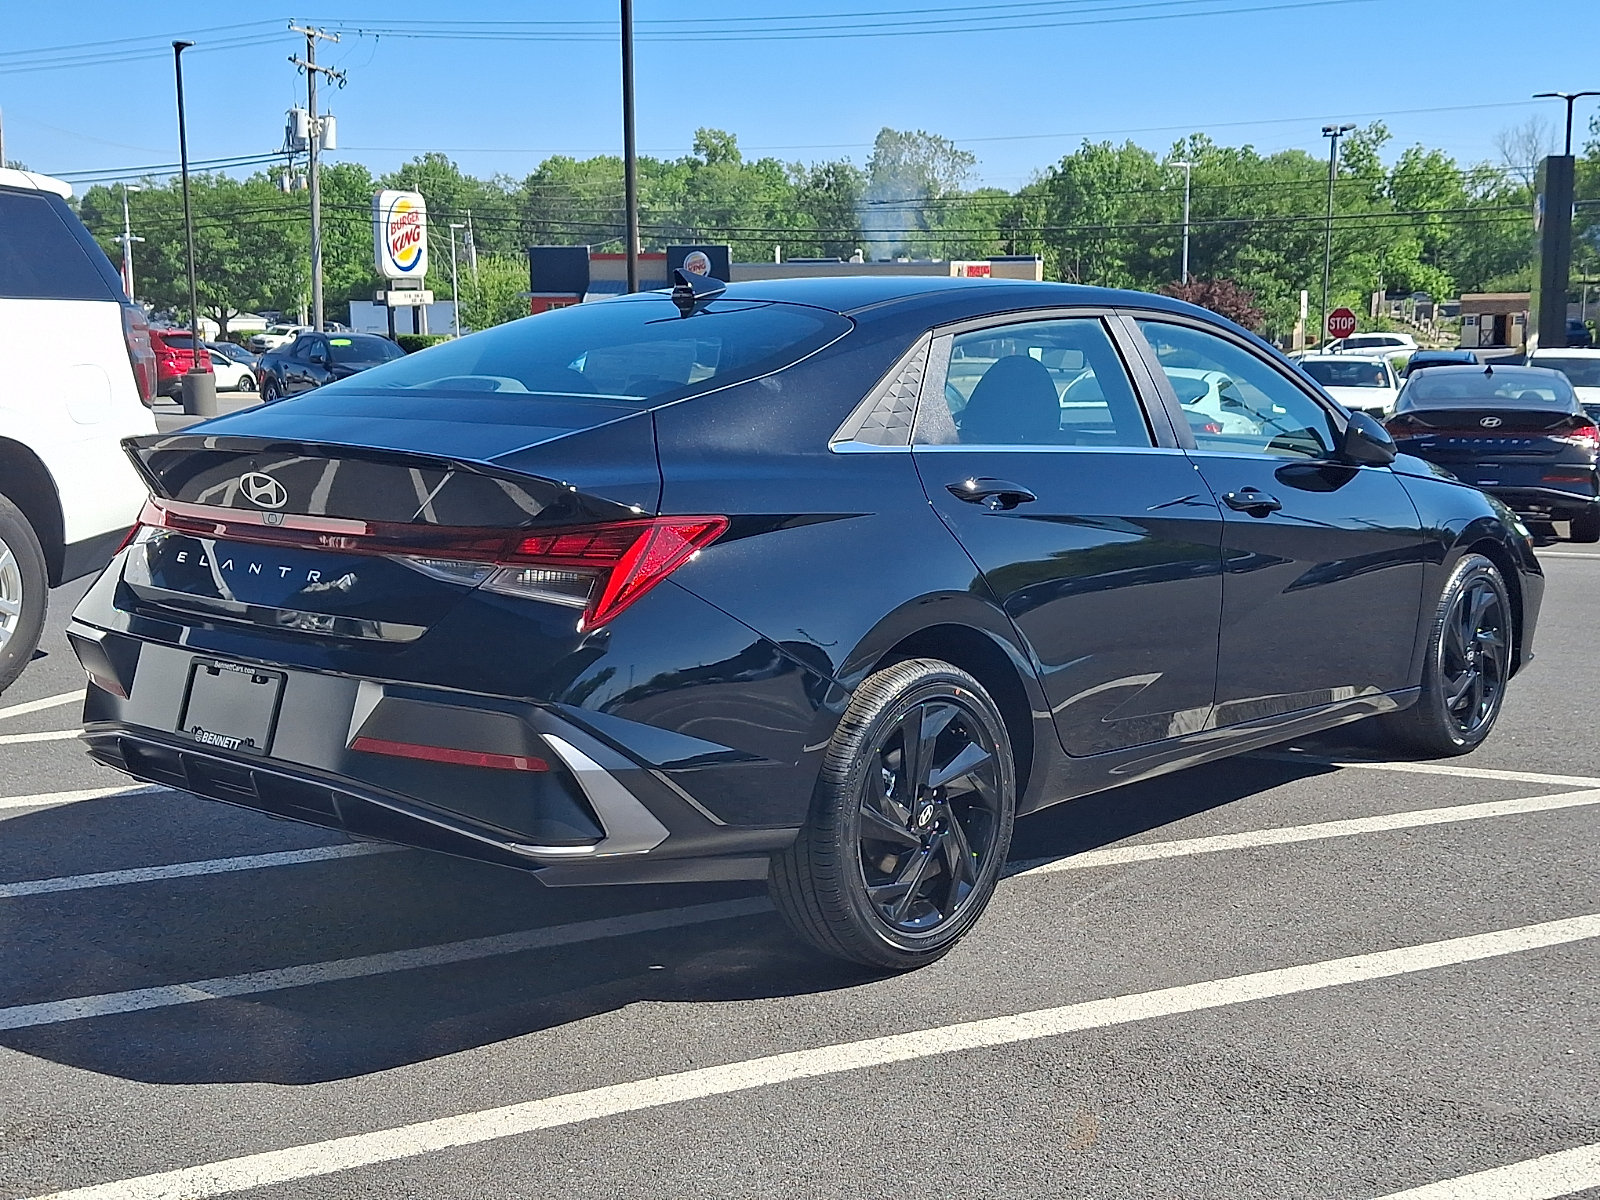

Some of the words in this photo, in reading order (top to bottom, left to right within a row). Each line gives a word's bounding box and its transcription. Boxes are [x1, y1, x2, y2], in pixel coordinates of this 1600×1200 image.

[391, 210, 419, 236] BURGER
[393, 225, 420, 257] KING
[1329, 317, 1355, 330] STOP
[176, 551, 352, 586] ELANTRA
[214, 660, 256, 675] BennettCars.com
[201, 732, 241, 750] BENNETT
